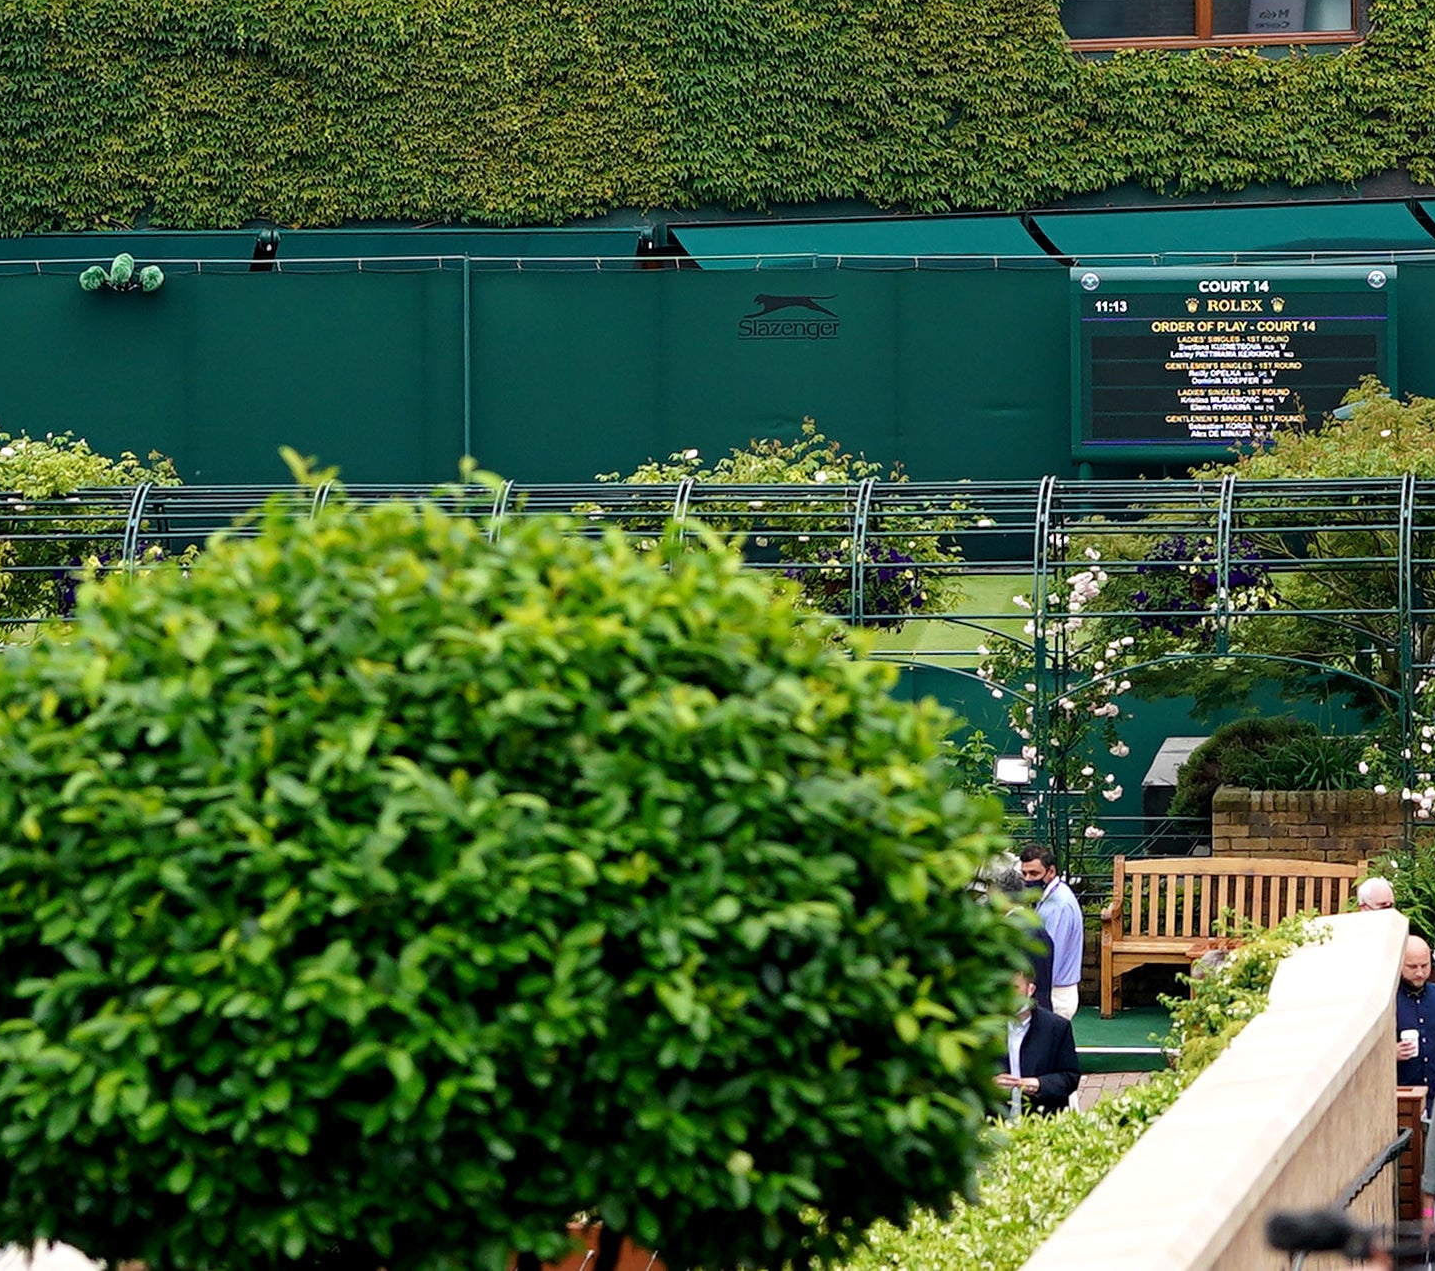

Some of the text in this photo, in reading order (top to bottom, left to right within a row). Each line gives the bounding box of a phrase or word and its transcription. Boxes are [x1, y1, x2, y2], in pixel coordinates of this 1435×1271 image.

[1198, 280, 1269, 293] COURT 14
[1095, 300, 1128, 312] 11:13
[1207, 299, 1263, 312] ROLEX
[738, 319, 840, 340] Slazenger
[1151, 321, 1195, 333] ORDER
[1197, 321, 1214, 333] OF
[1216, 321, 1248, 333] PLAY
[1258, 321, 1300, 333] COURT
[1302, 321, 1316, 333] 14
